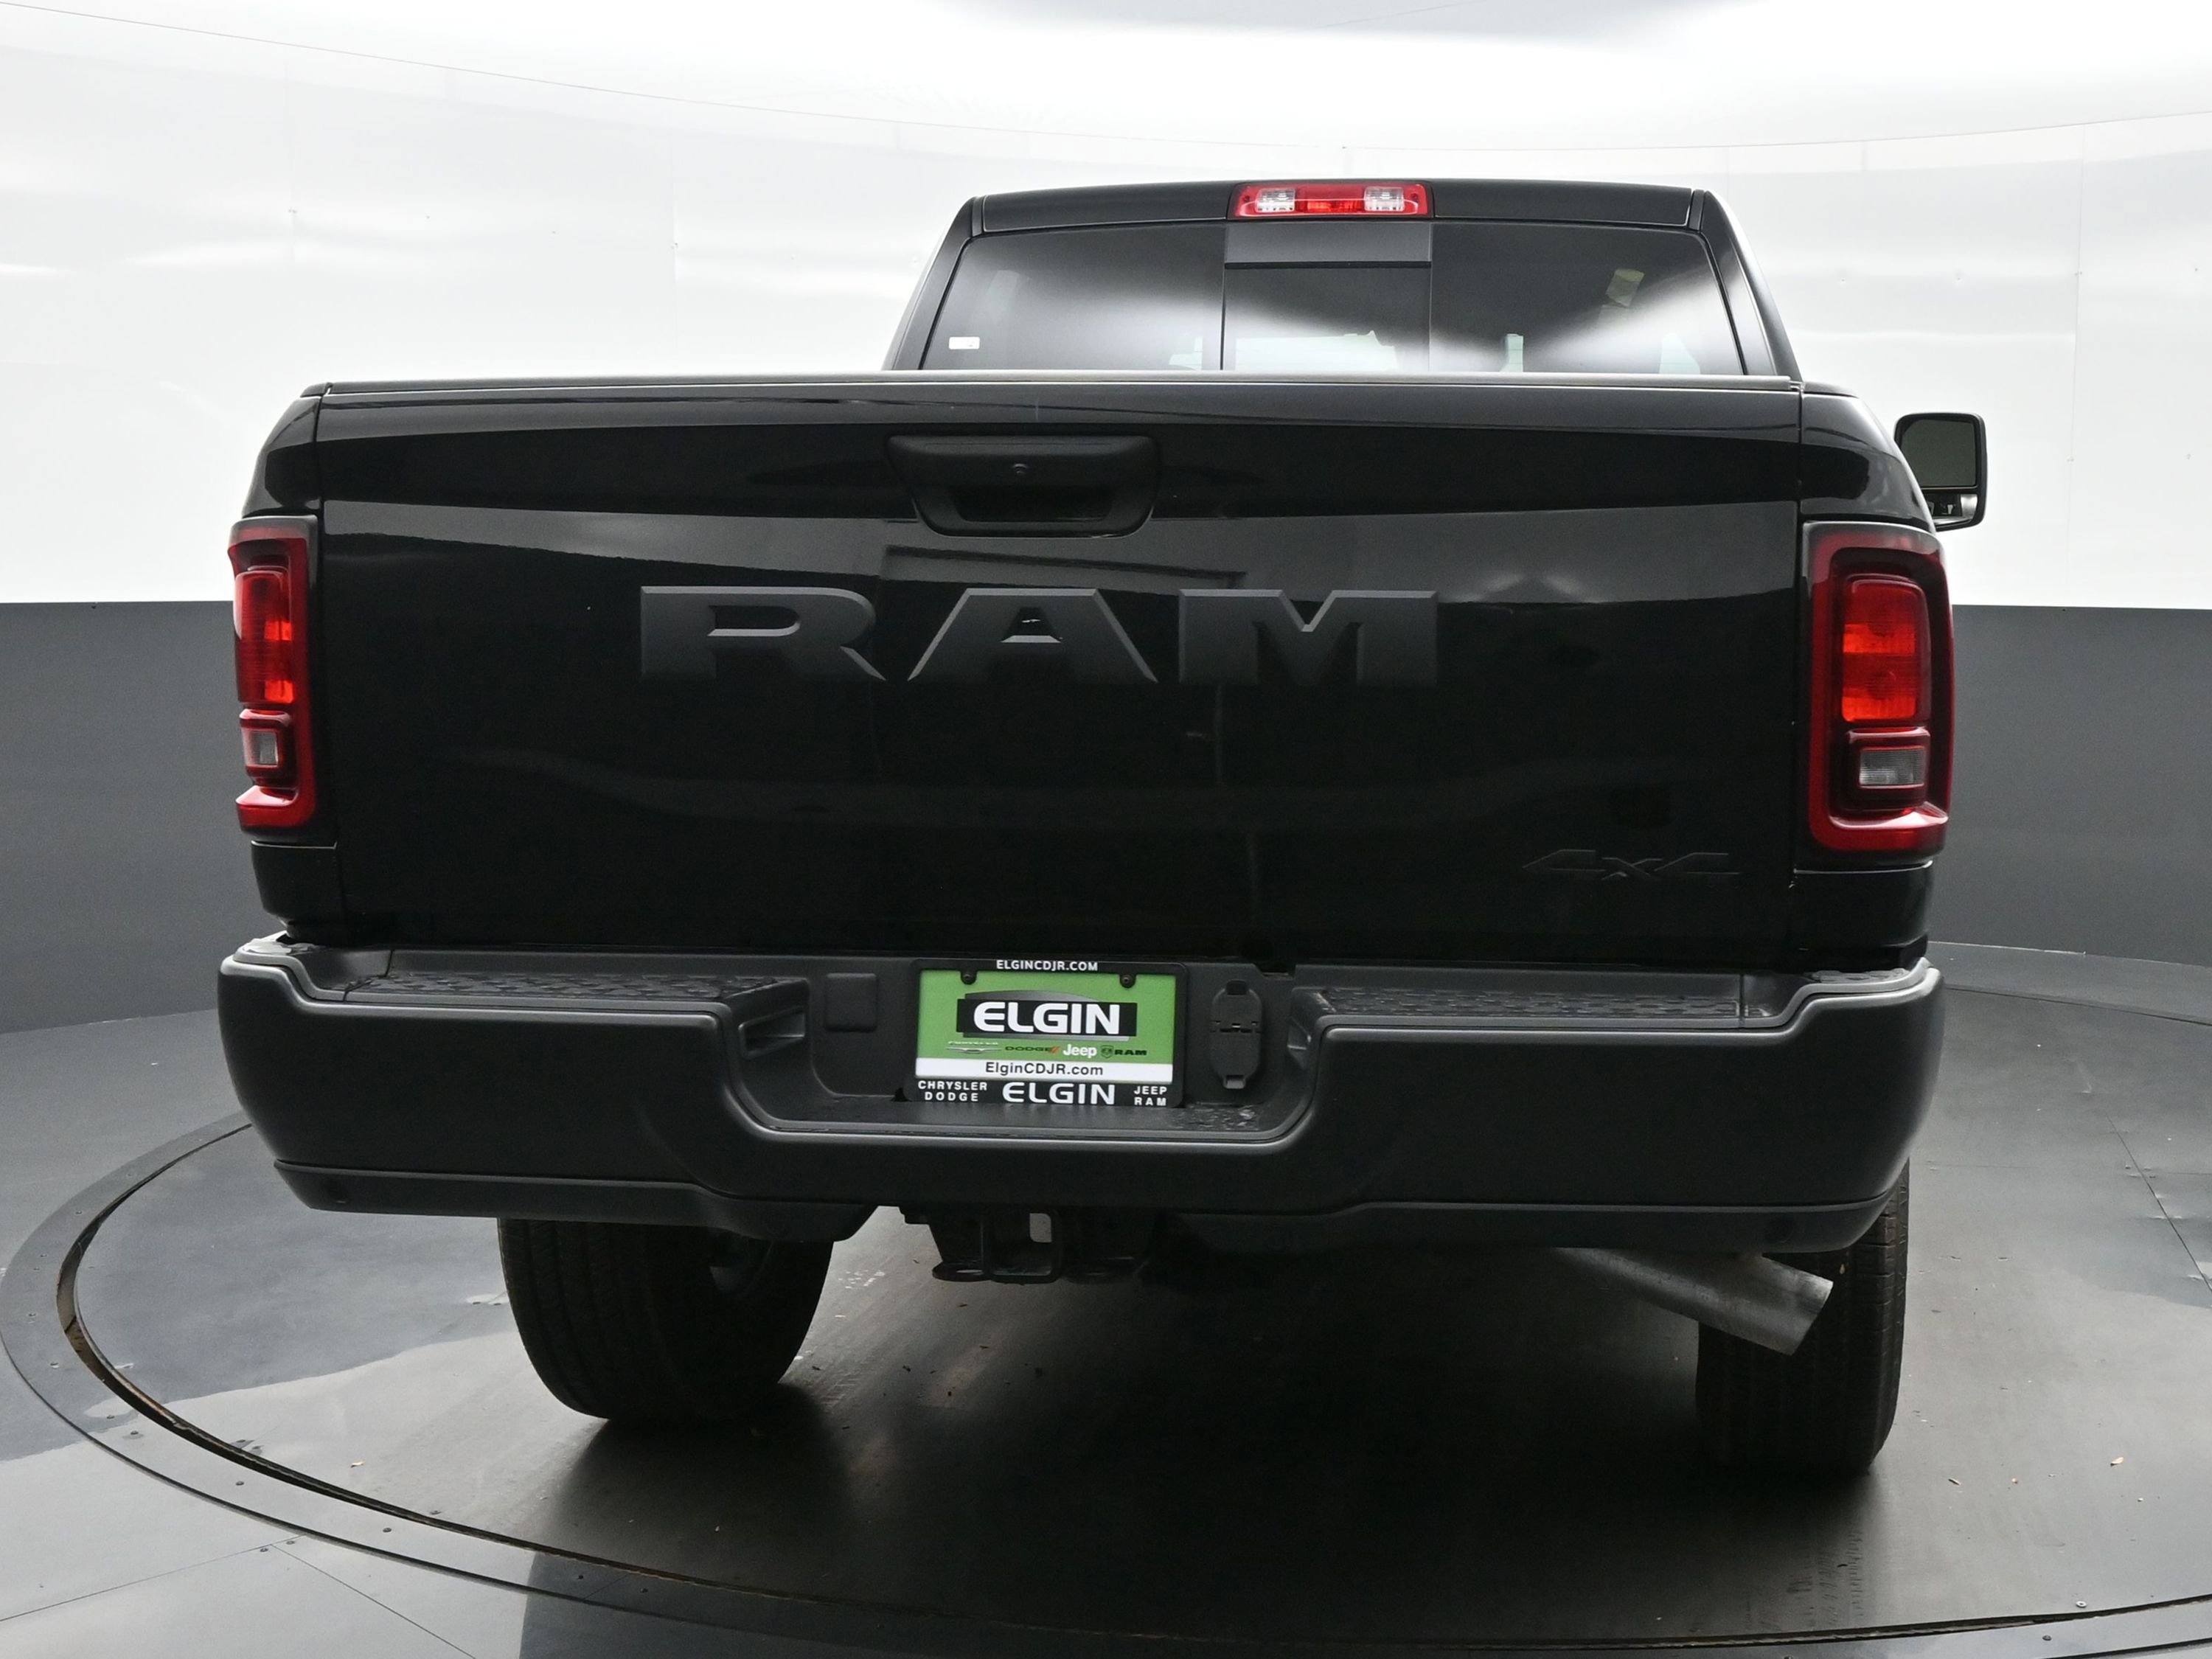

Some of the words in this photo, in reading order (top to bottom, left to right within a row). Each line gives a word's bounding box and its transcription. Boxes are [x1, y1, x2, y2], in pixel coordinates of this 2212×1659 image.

[640, 585, 1437, 687] RAM
[996, 959, 1098, 972] ELGINCDJR.COM
[973, 1001, 1120, 1034] ELGIN
[1062, 1043, 1098, 1059] Jeep
[985, 1062, 1103, 1077] ElginCDJR.com
[918, 1080, 987, 1091] CHRYSLER
[1134, 1085, 1167, 1096] JEEP
[925, 1091, 979, 1102] DODGE
[1003, 1082, 1116, 1105] ELGIN
[1134, 1096, 1167, 1107] RAM
